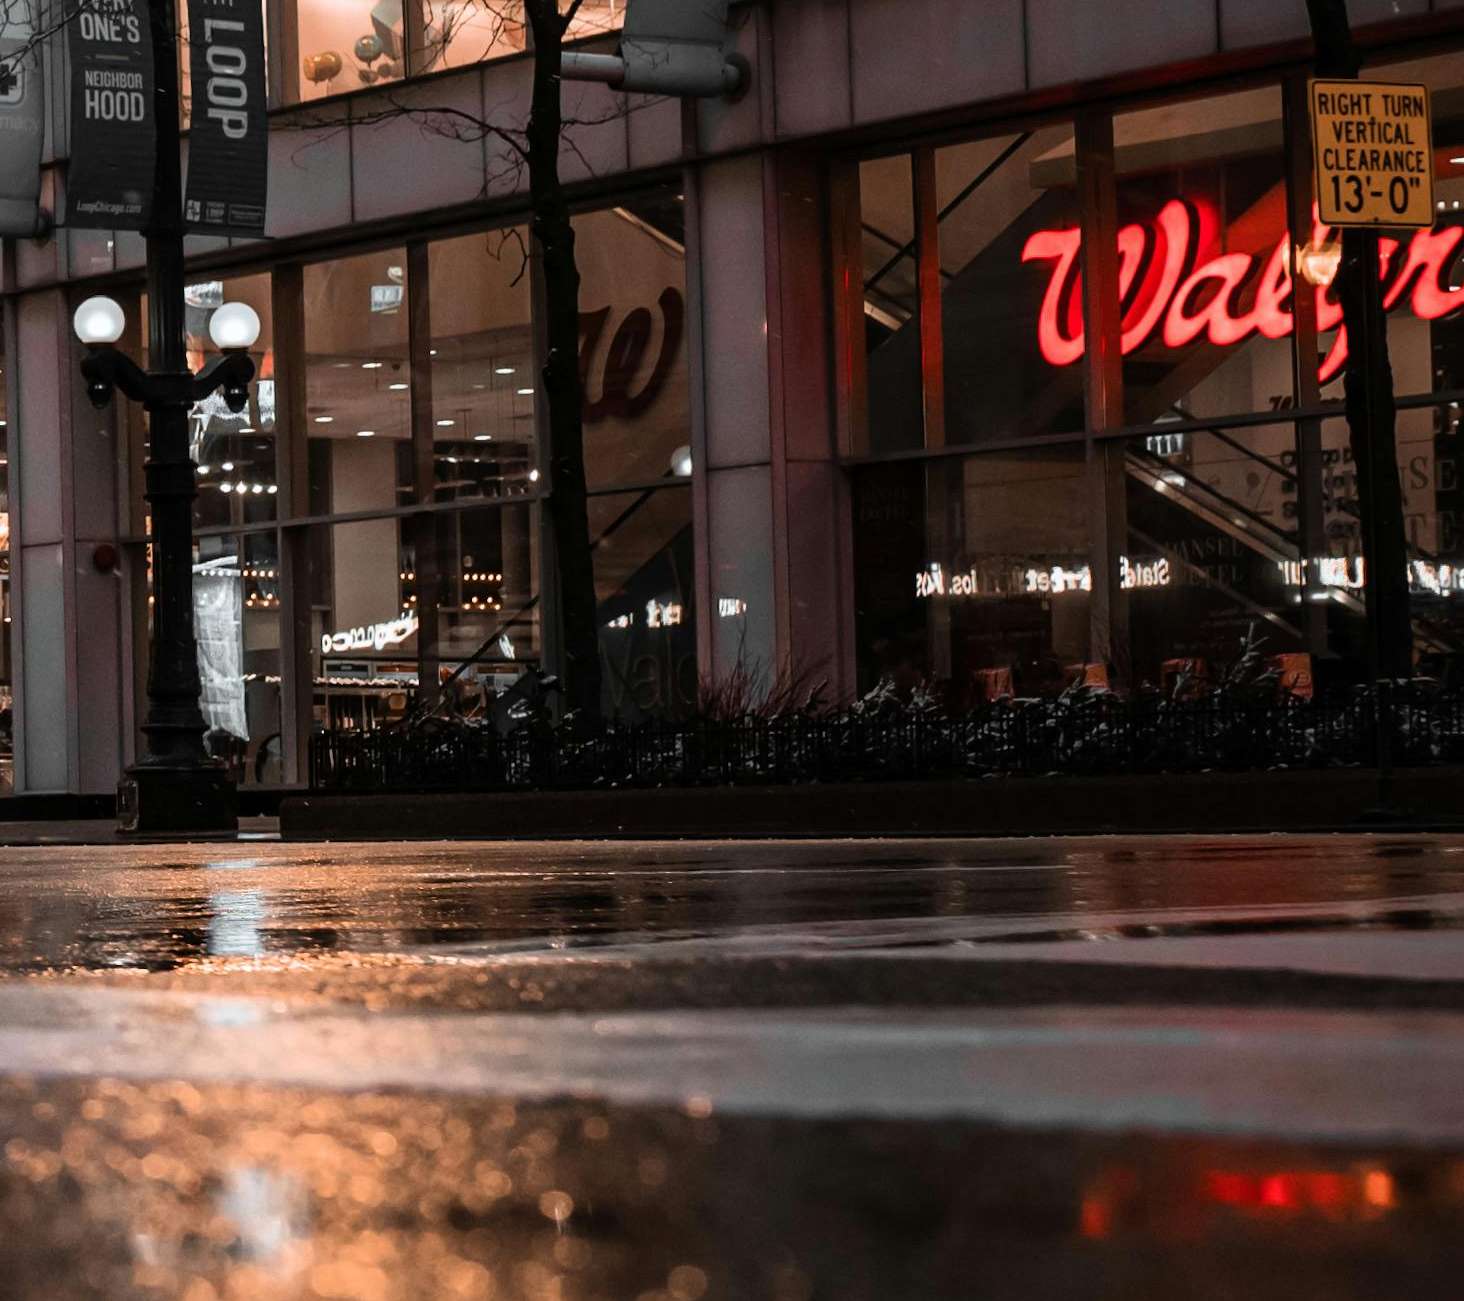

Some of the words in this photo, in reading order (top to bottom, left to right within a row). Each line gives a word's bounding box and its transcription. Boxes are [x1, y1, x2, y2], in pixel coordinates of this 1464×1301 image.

[79, 12, 141, 44] ONE'S
[85, 70, 143, 90] NEIGHBOR
[203, 18, 249, 140] LOOP
[85, 92, 145, 122] HOOD
[1318, 93, 1371, 115] RIGHT
[1382, 94, 1424, 118] TURN
[1332, 120, 1414, 145] VERTICAL
[1323, 148, 1426, 173] CLEARANCE
